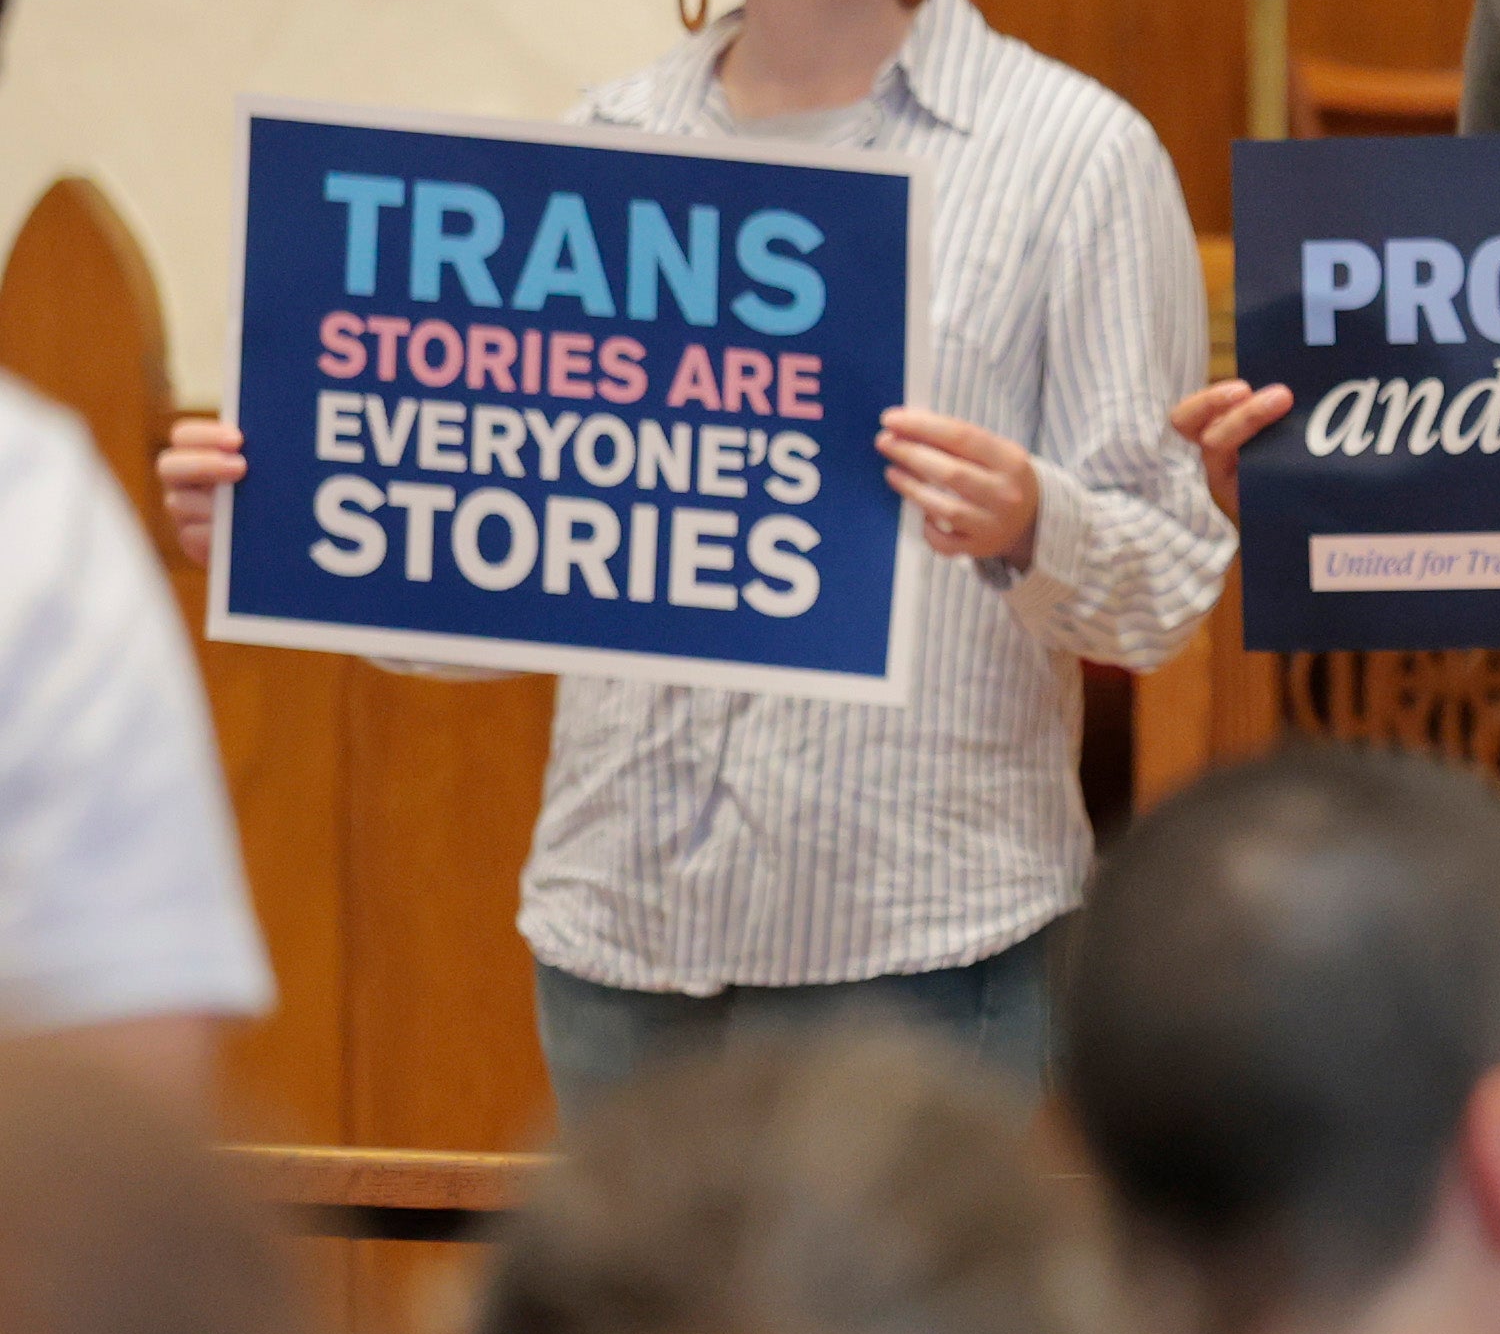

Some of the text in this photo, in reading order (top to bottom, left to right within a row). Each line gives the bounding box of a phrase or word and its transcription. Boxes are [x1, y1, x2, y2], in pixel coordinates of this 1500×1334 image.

[323, 170, 828, 337] TRANS
[316, 310, 825, 420] STORIES ARE
[315, 389, 822, 505] EVERYONE'S
[308, 473, 822, 619] STORIES
[1326, 548, 1412, 578] United
[1416, 551, 1460, 581] for
